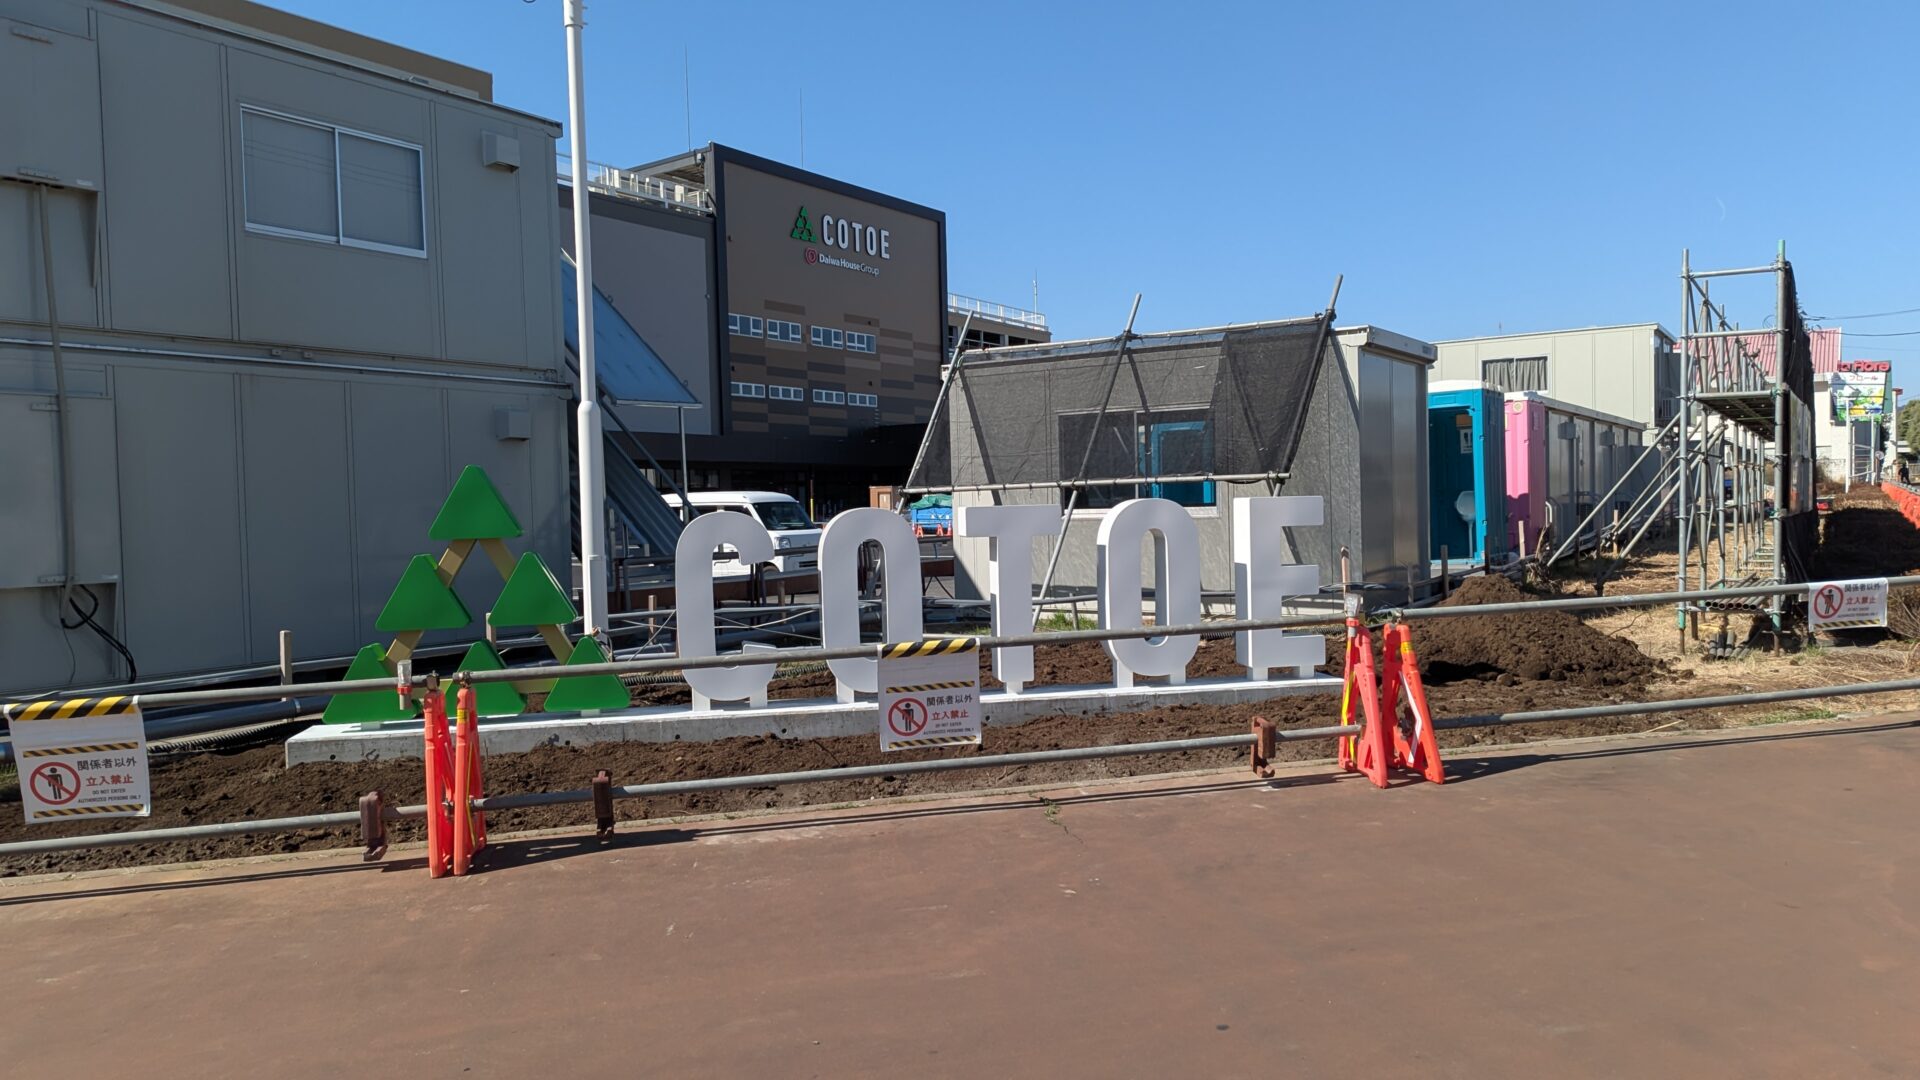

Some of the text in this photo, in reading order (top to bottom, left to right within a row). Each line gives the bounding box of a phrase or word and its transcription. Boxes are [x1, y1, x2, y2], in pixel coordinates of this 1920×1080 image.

[822, 214, 891, 260] COTOE
[675, 496, 1327, 700] COTOE
[926, 694, 973, 706] 関係者以外
[931, 709, 969, 720] 立入禁止
[77, 756, 137, 771] 関係者以外
[86, 773, 134, 787] 立入禁止
